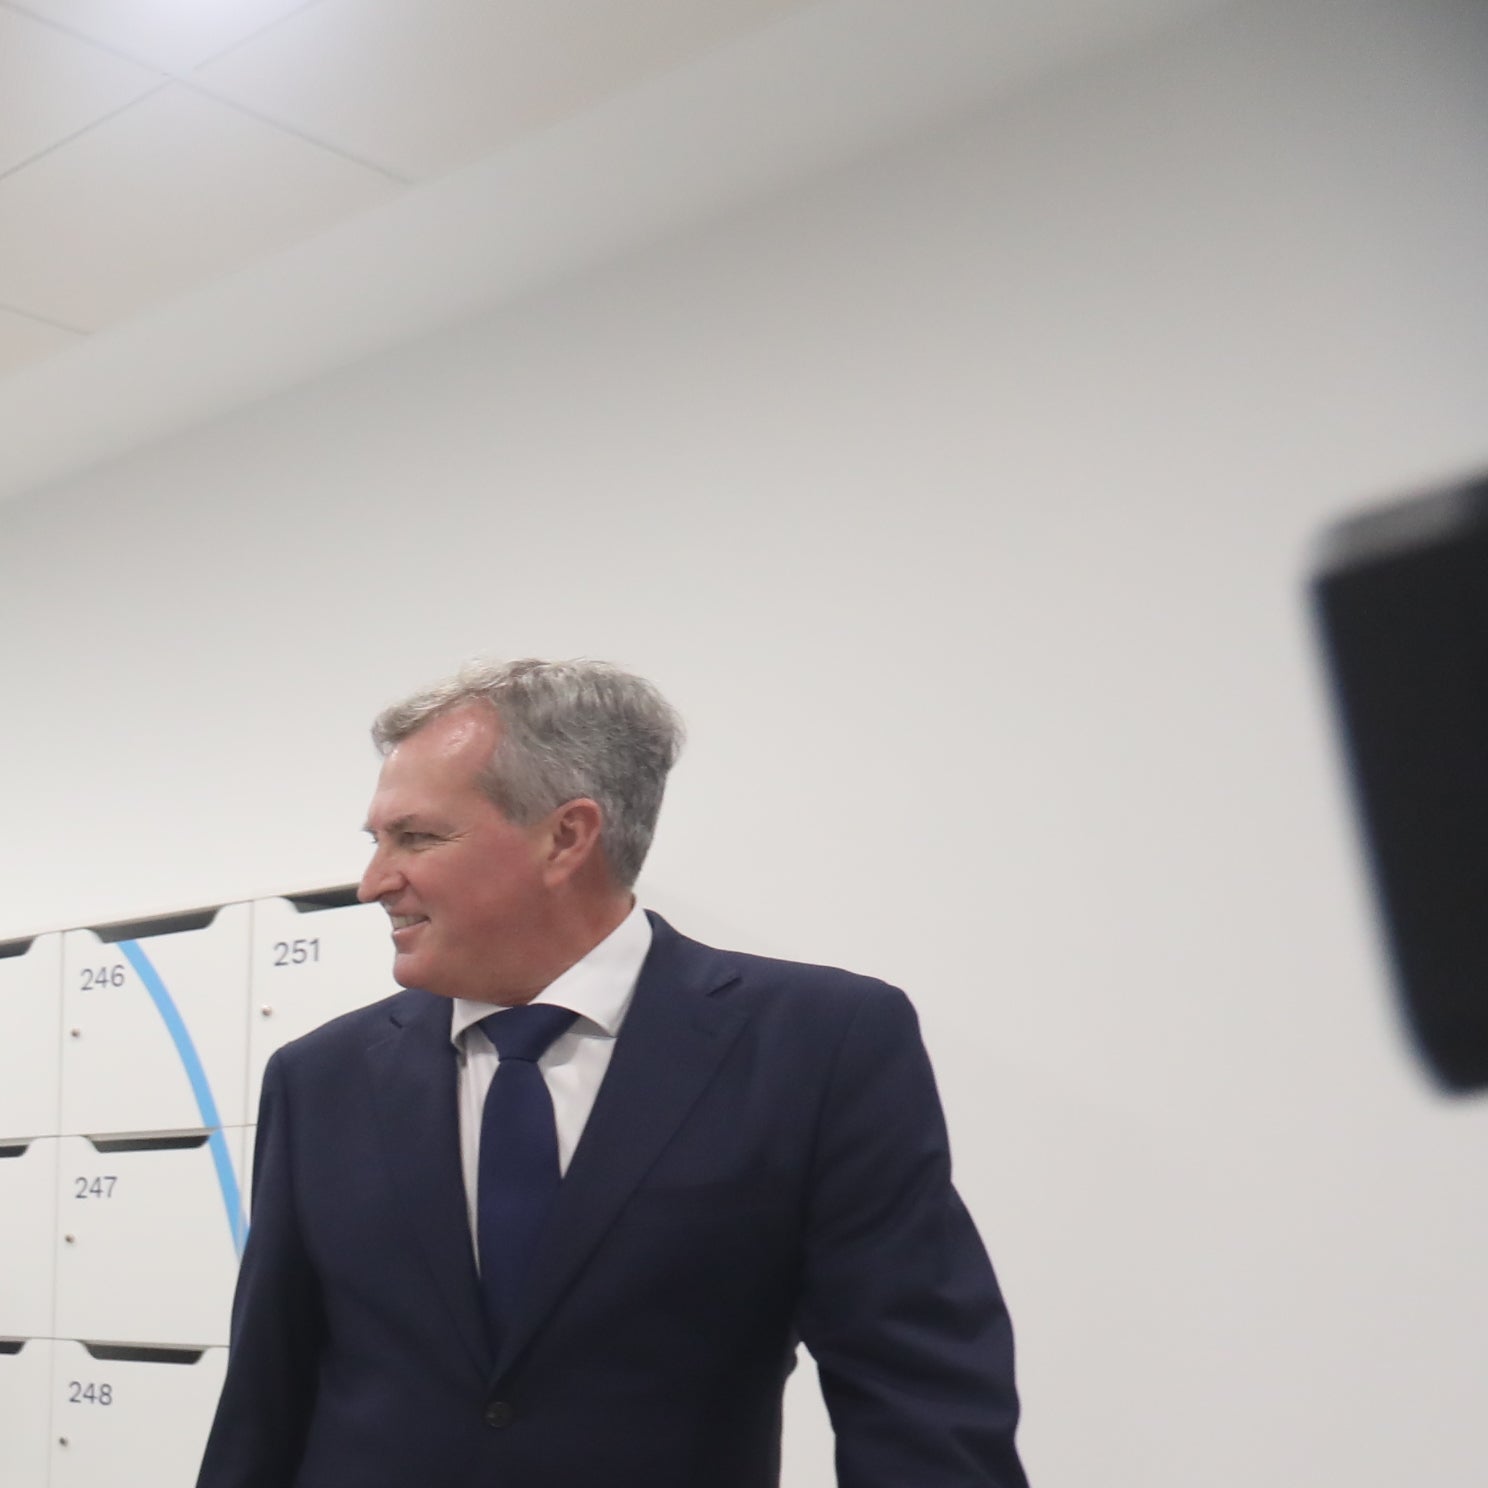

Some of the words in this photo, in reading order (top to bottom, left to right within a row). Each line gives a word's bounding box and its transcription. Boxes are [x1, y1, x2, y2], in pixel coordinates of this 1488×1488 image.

[273, 938, 319, 967] 251
[80, 964, 125, 991] 246
[74, 1175, 118, 1200] 247
[68, 1381, 113, 1406] 248
